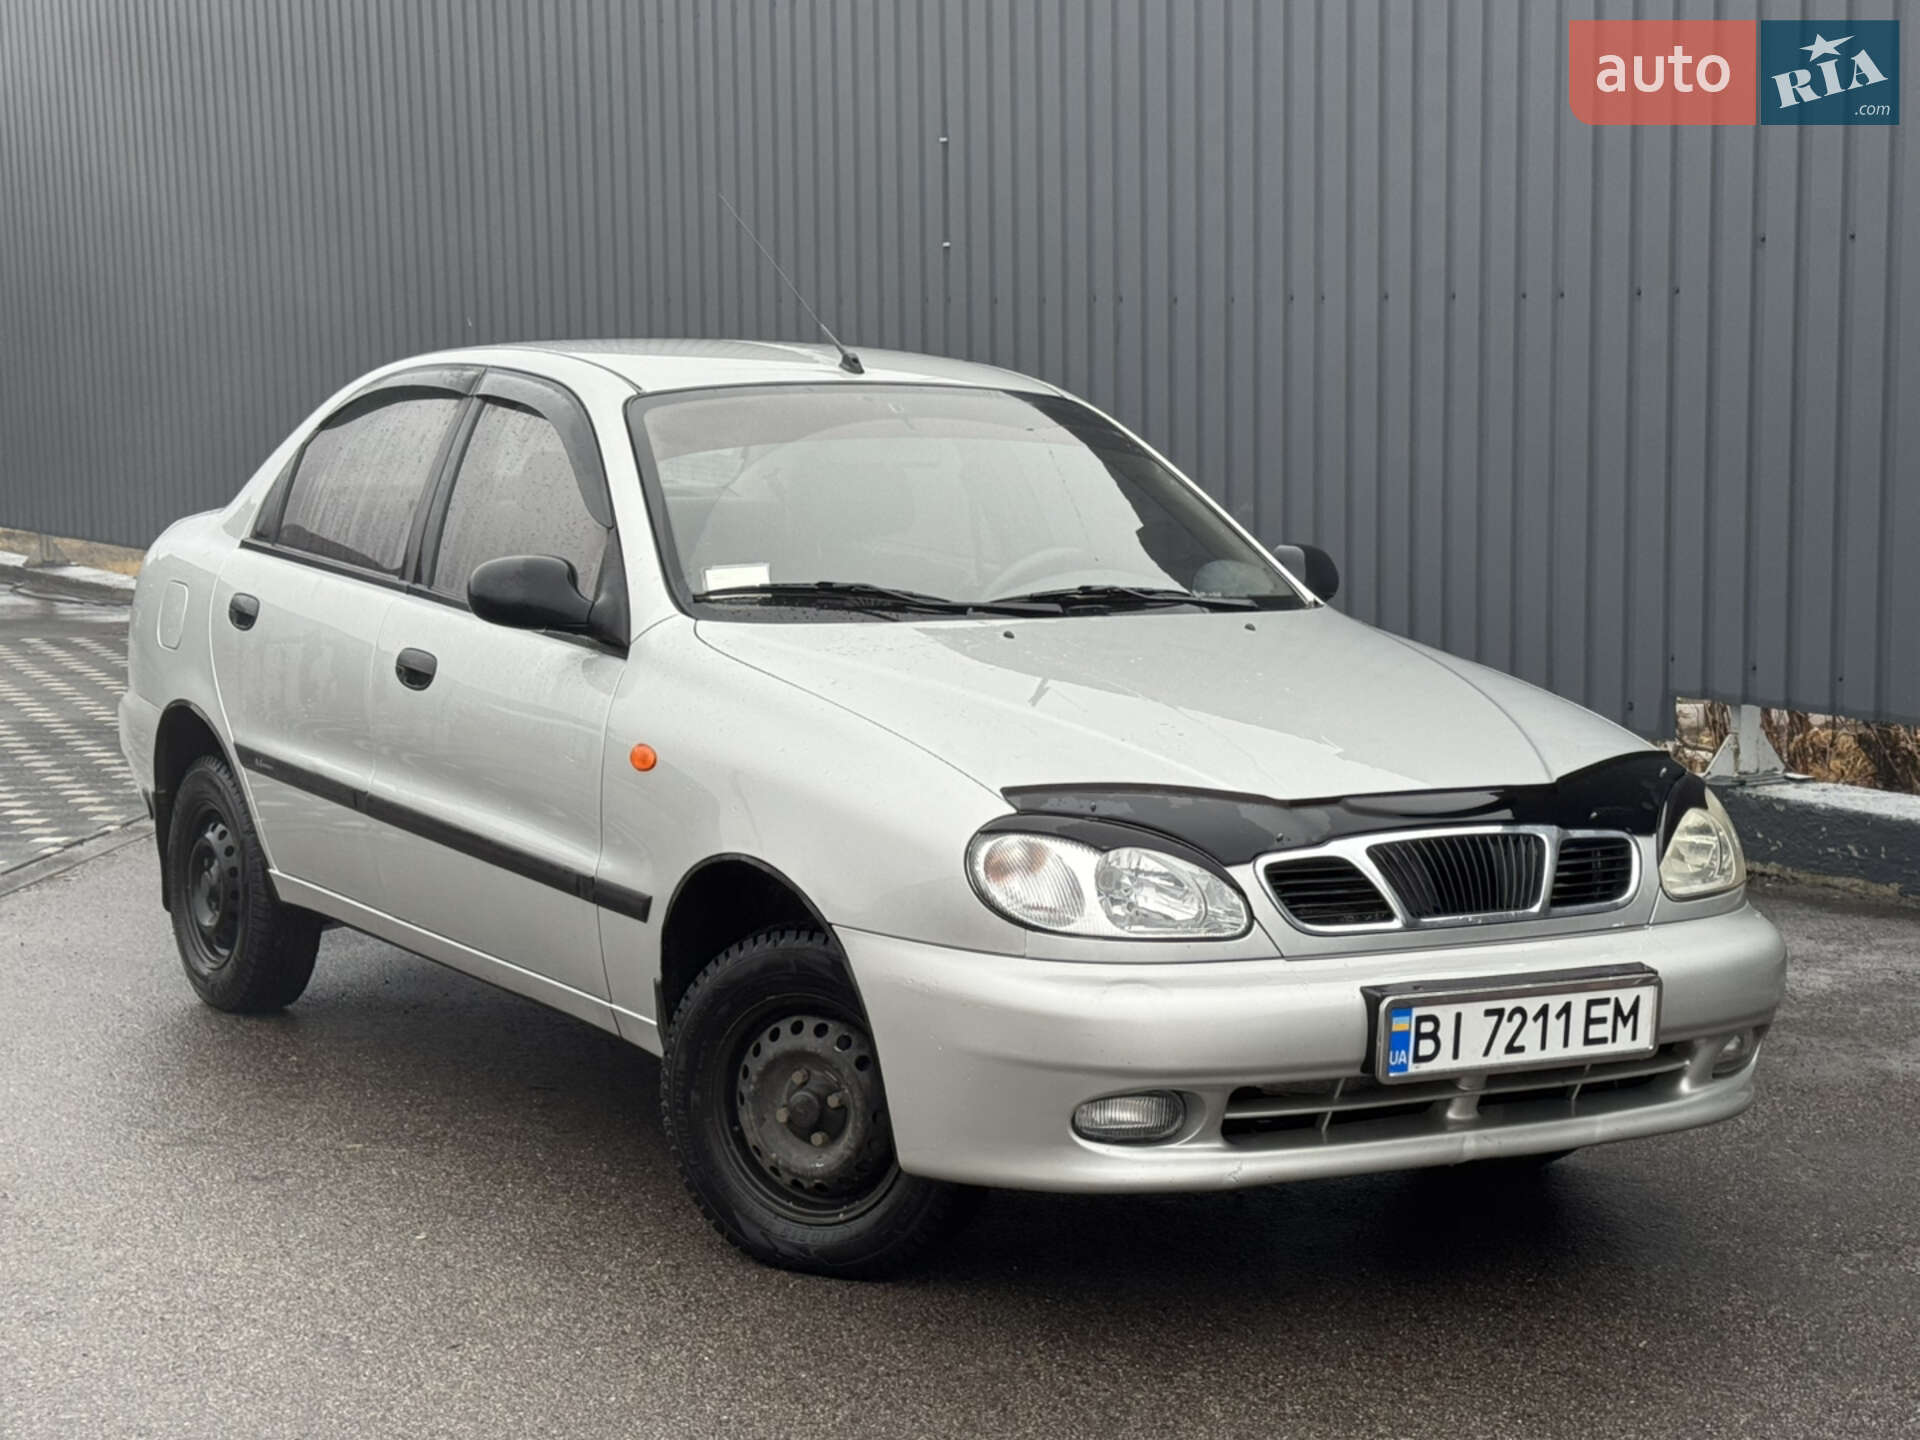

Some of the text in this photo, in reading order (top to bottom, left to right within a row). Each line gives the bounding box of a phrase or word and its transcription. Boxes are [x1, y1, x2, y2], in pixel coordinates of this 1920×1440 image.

[1412, 994, 1641, 1065] BI 7211 EM
[1388, 1049, 1408, 1066] UA
